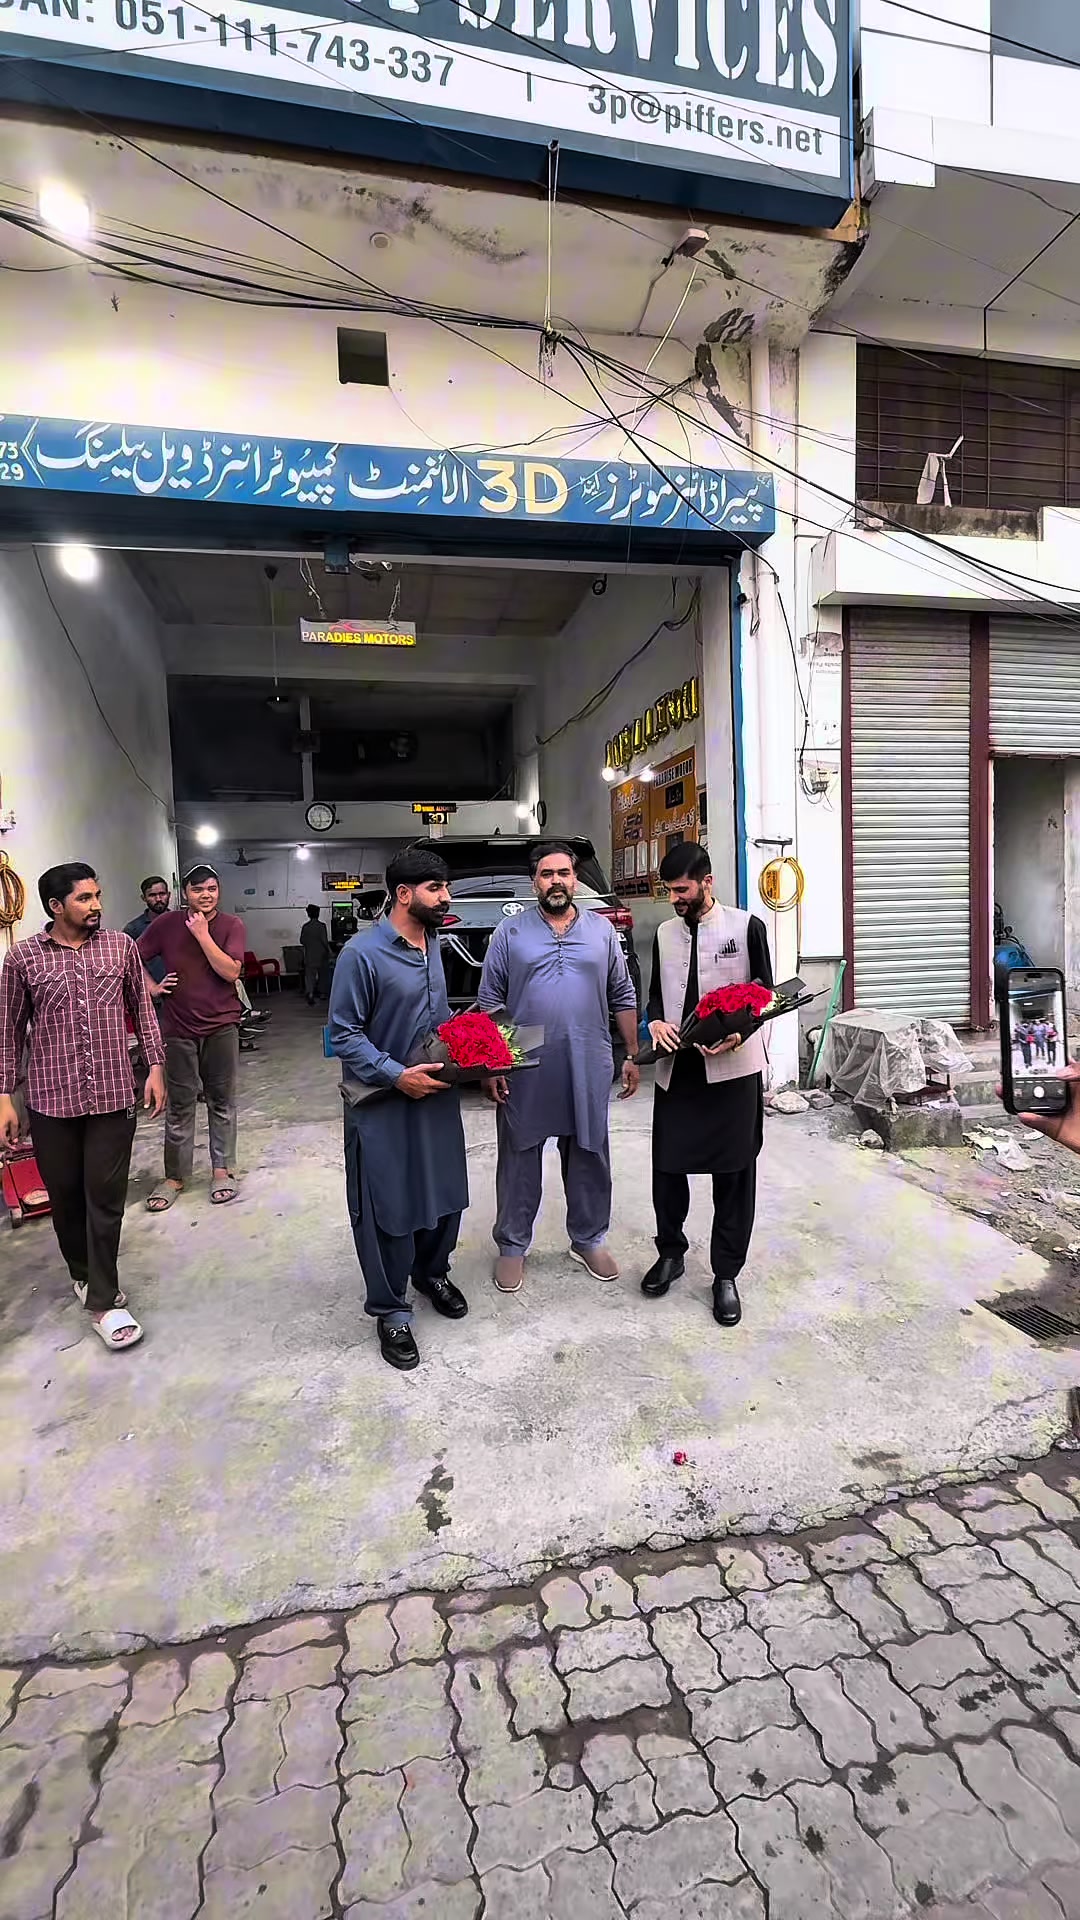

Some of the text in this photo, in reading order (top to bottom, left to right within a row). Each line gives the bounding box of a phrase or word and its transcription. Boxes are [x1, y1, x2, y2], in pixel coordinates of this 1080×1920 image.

[0, 0, 455, 86] AN: 051-111-743-337
[459, 0, 837, 97] VICES
[588, 84, 822, 155] 3p@piffers.net
[477, 460, 568, 514] 3D
[302, 631, 414, 646] PARADIES MOTORS
